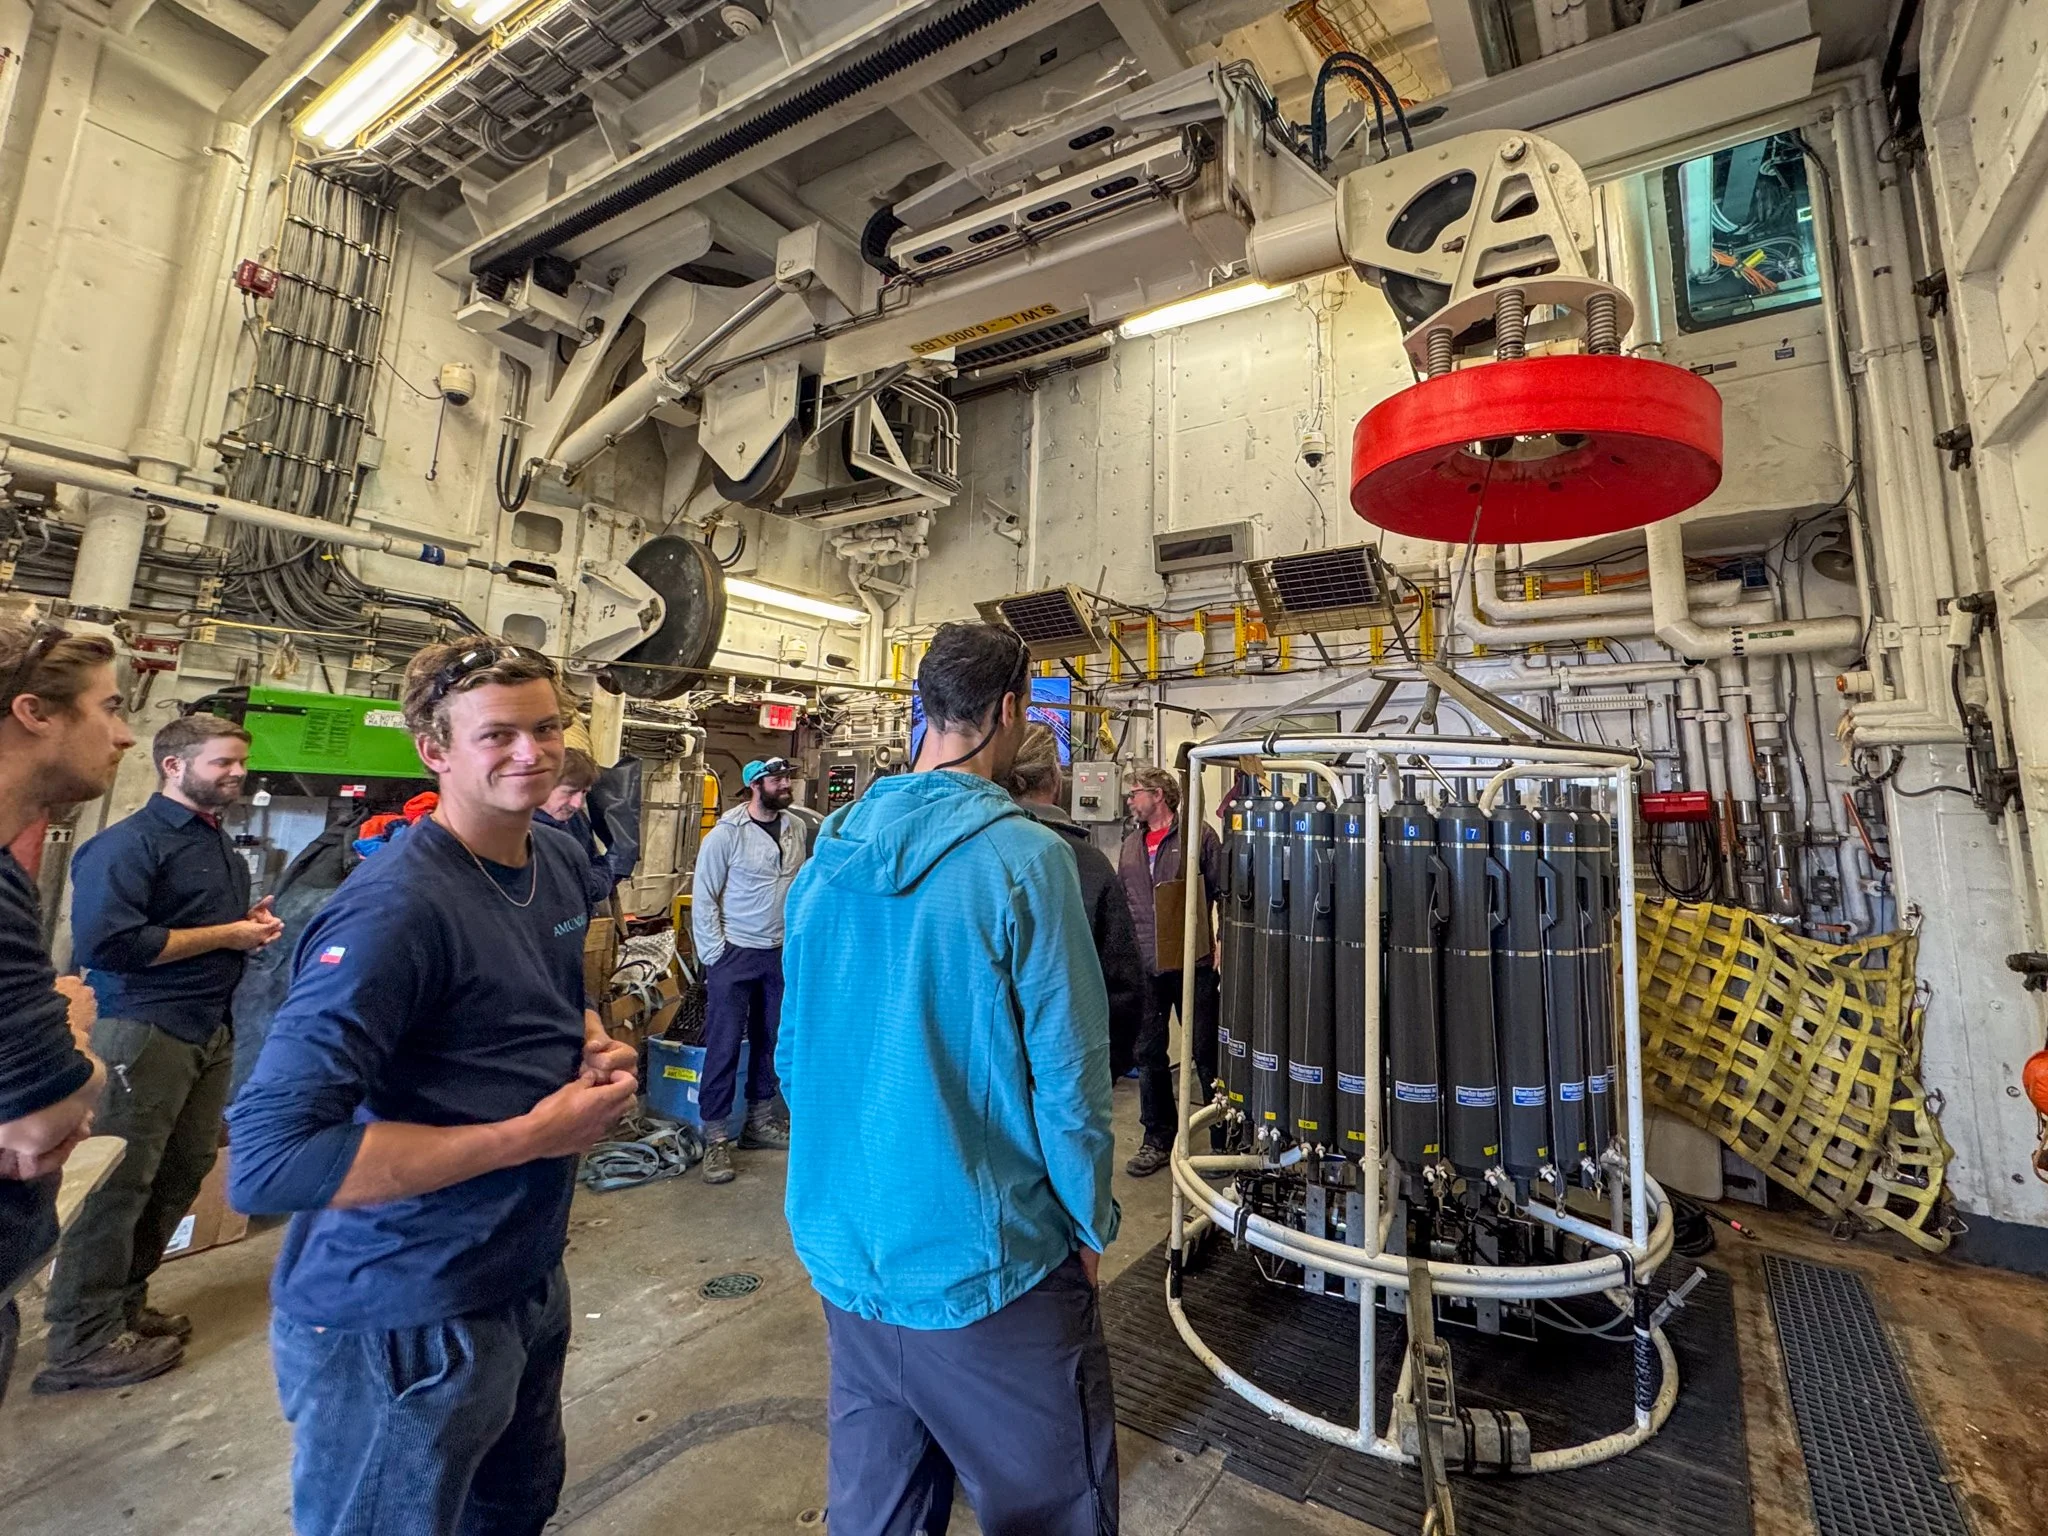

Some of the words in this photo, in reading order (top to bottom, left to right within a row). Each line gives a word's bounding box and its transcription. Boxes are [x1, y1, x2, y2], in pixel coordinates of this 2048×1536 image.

[947, 326, 989, 344] 6,000
[910, 335, 947, 353] LBS
[769, 705, 793, 727] EXIT
[1295, 820, 1306, 832] 10
[1348, 823, 1356, 834] 9
[1408, 826, 1415, 837] 8
[1470, 828, 1477, 839] 7
[1524, 830, 1531, 841] 6
[1568, 832, 1574, 843] 5
